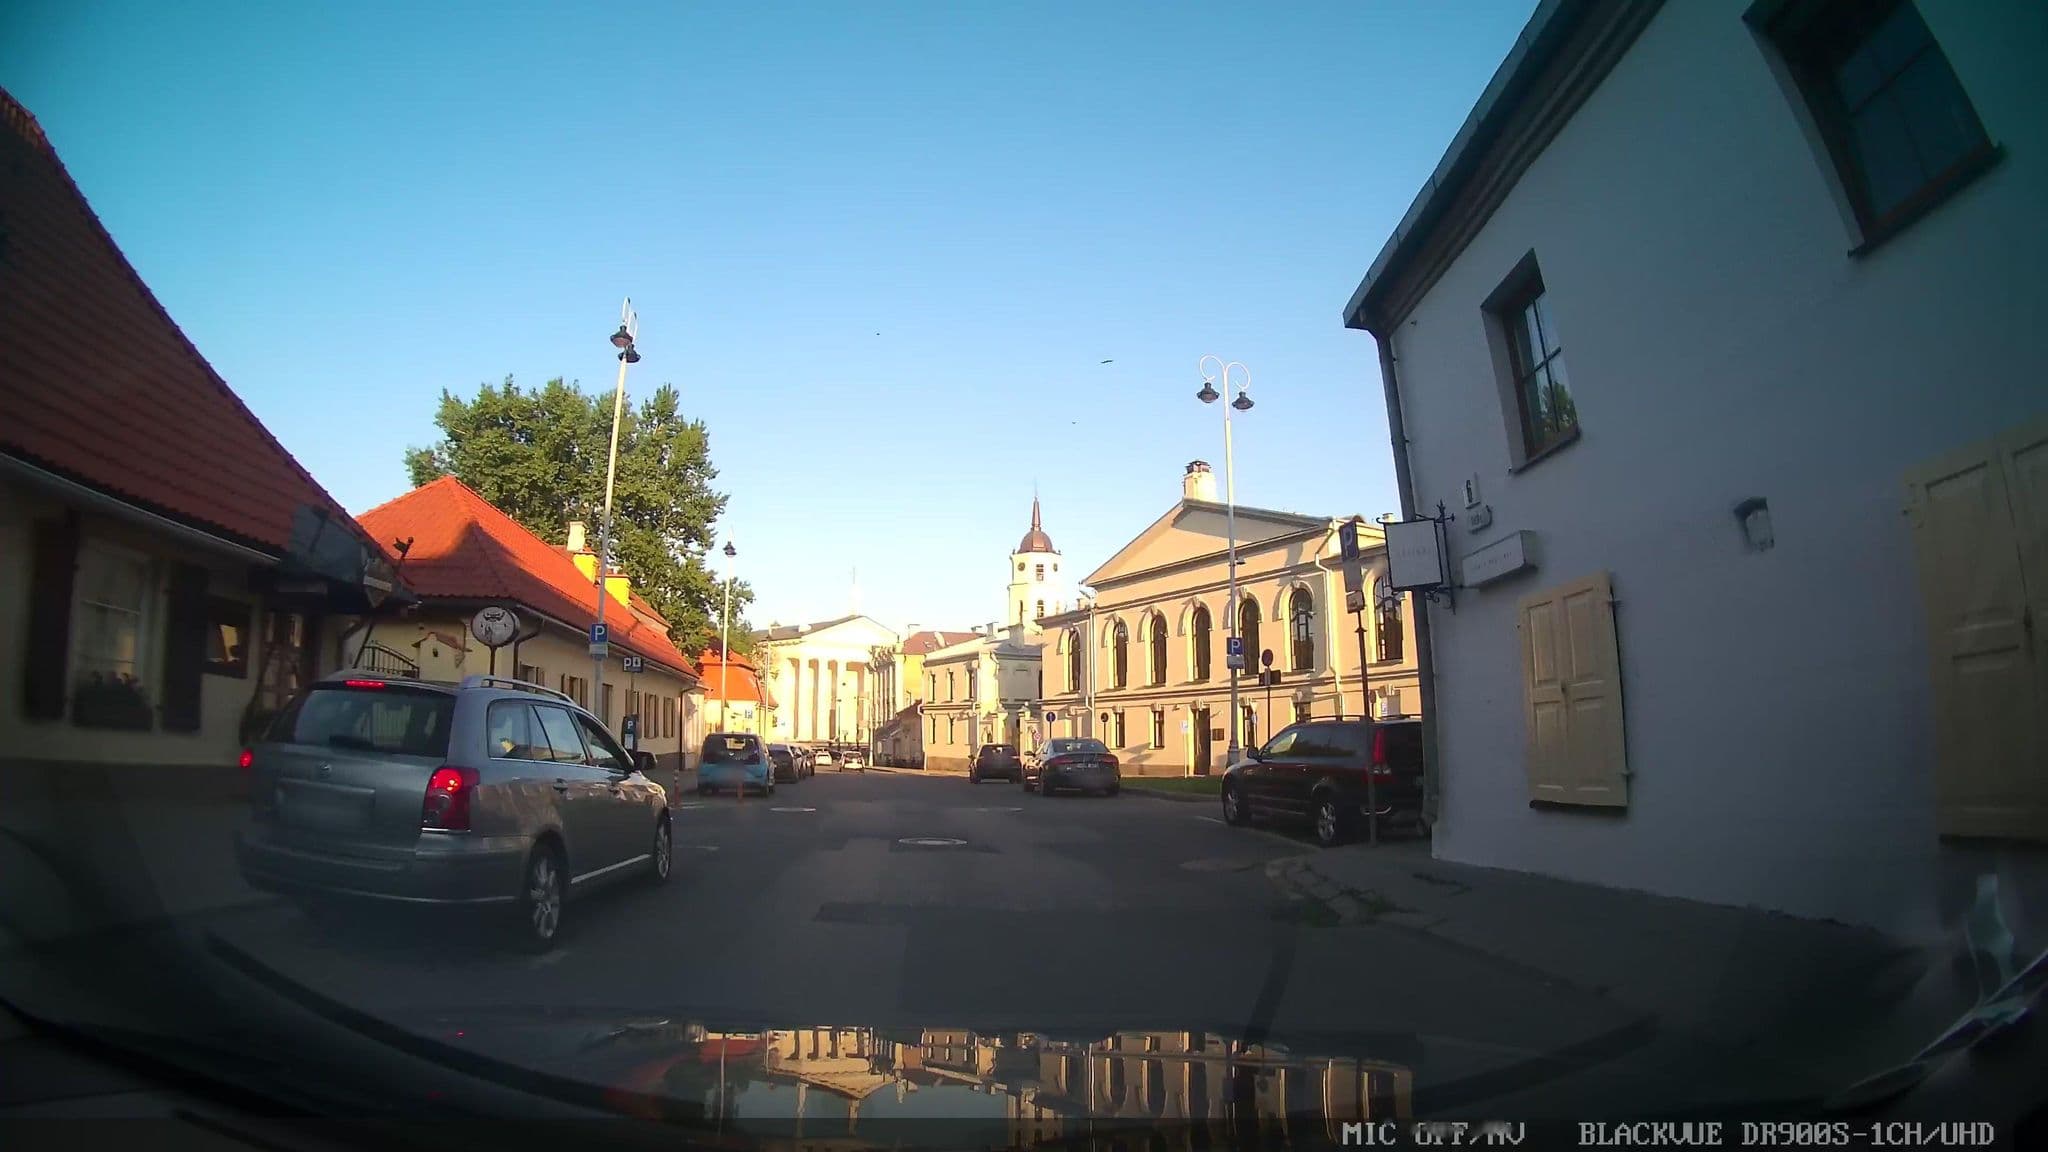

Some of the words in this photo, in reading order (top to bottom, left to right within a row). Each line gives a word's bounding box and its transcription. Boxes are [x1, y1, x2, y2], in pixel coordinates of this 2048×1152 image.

[1343, 527, 1353, 557] P
[595, 625, 605, 640] P
[1231, 639, 1241, 654] P
[624, 657, 632, 671] P
[627, 720, 634, 729] P
